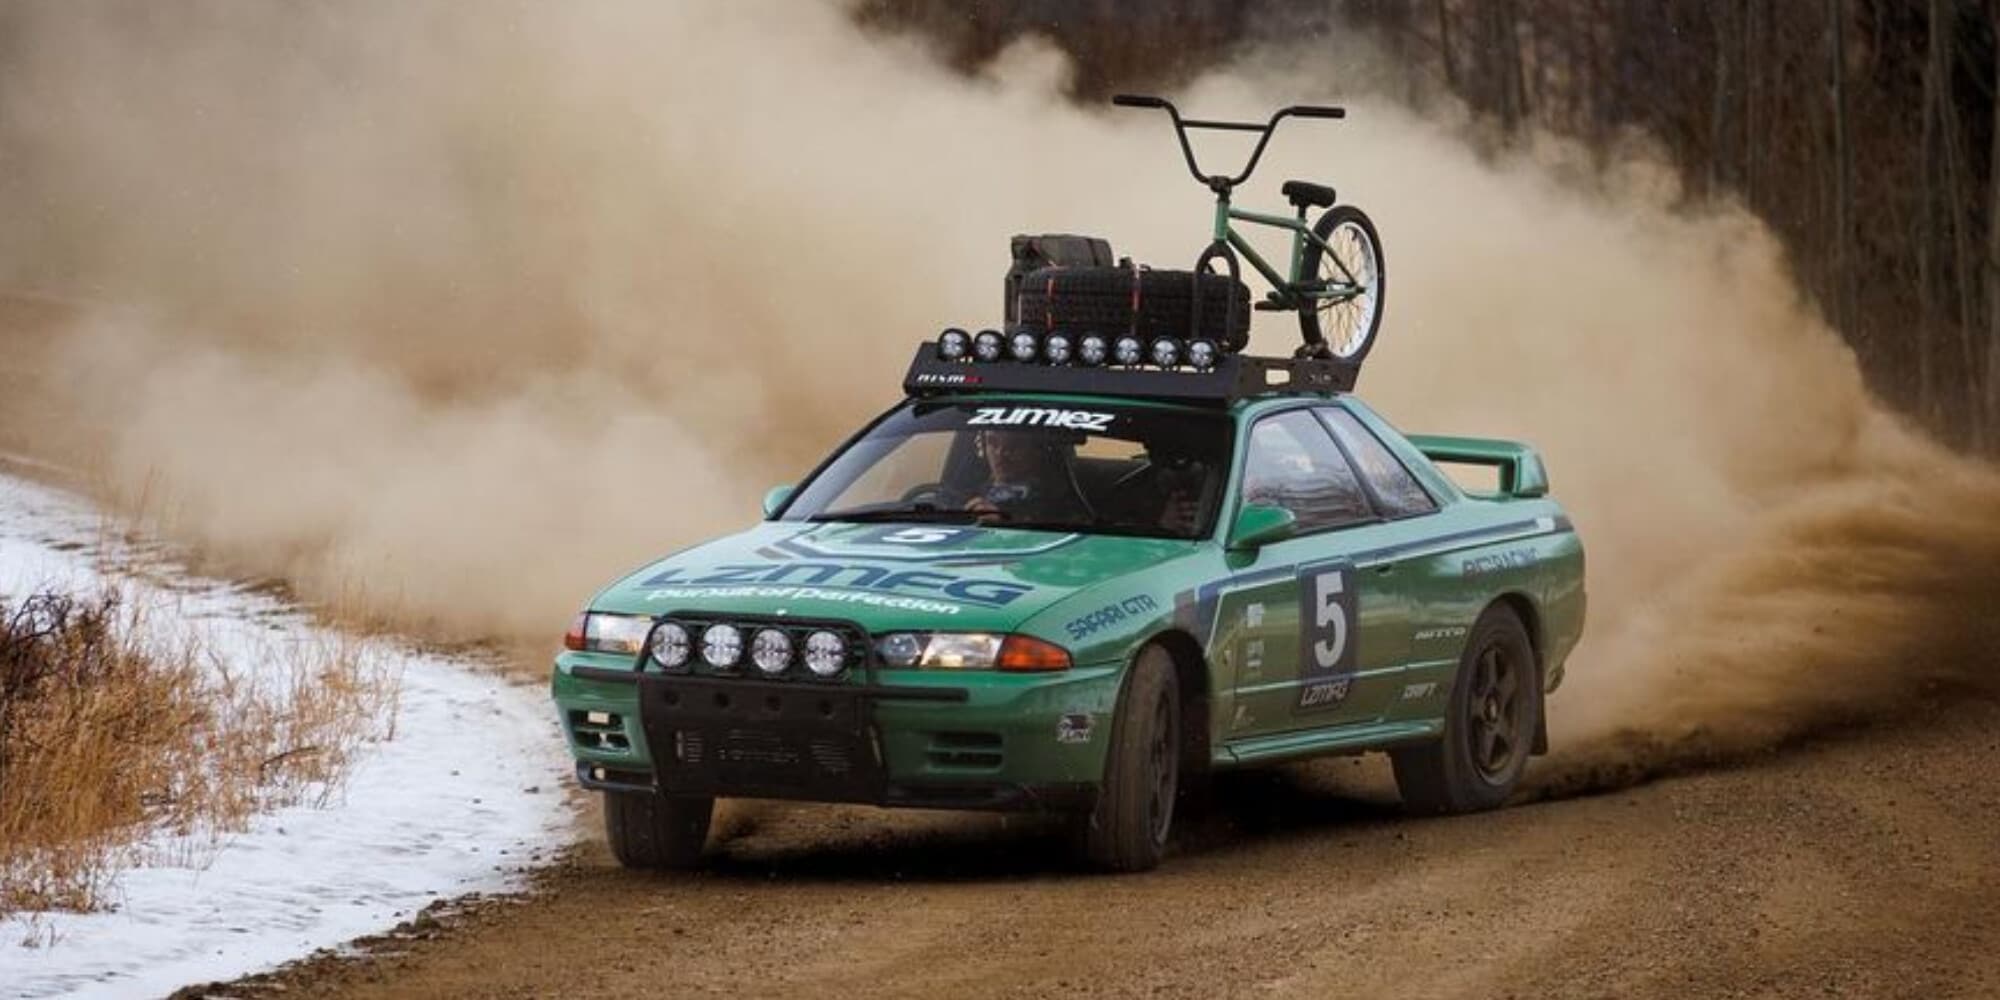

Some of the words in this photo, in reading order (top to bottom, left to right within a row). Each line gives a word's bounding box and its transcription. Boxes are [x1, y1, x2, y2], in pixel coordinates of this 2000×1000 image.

[881, 528, 962, 544] 5
[642, 563, 1034, 606] LZMFG
[1066, 603, 1126, 641] SAFARI
[1122, 593, 1159, 616] GTR
[1314, 571, 1347, 668] 5
